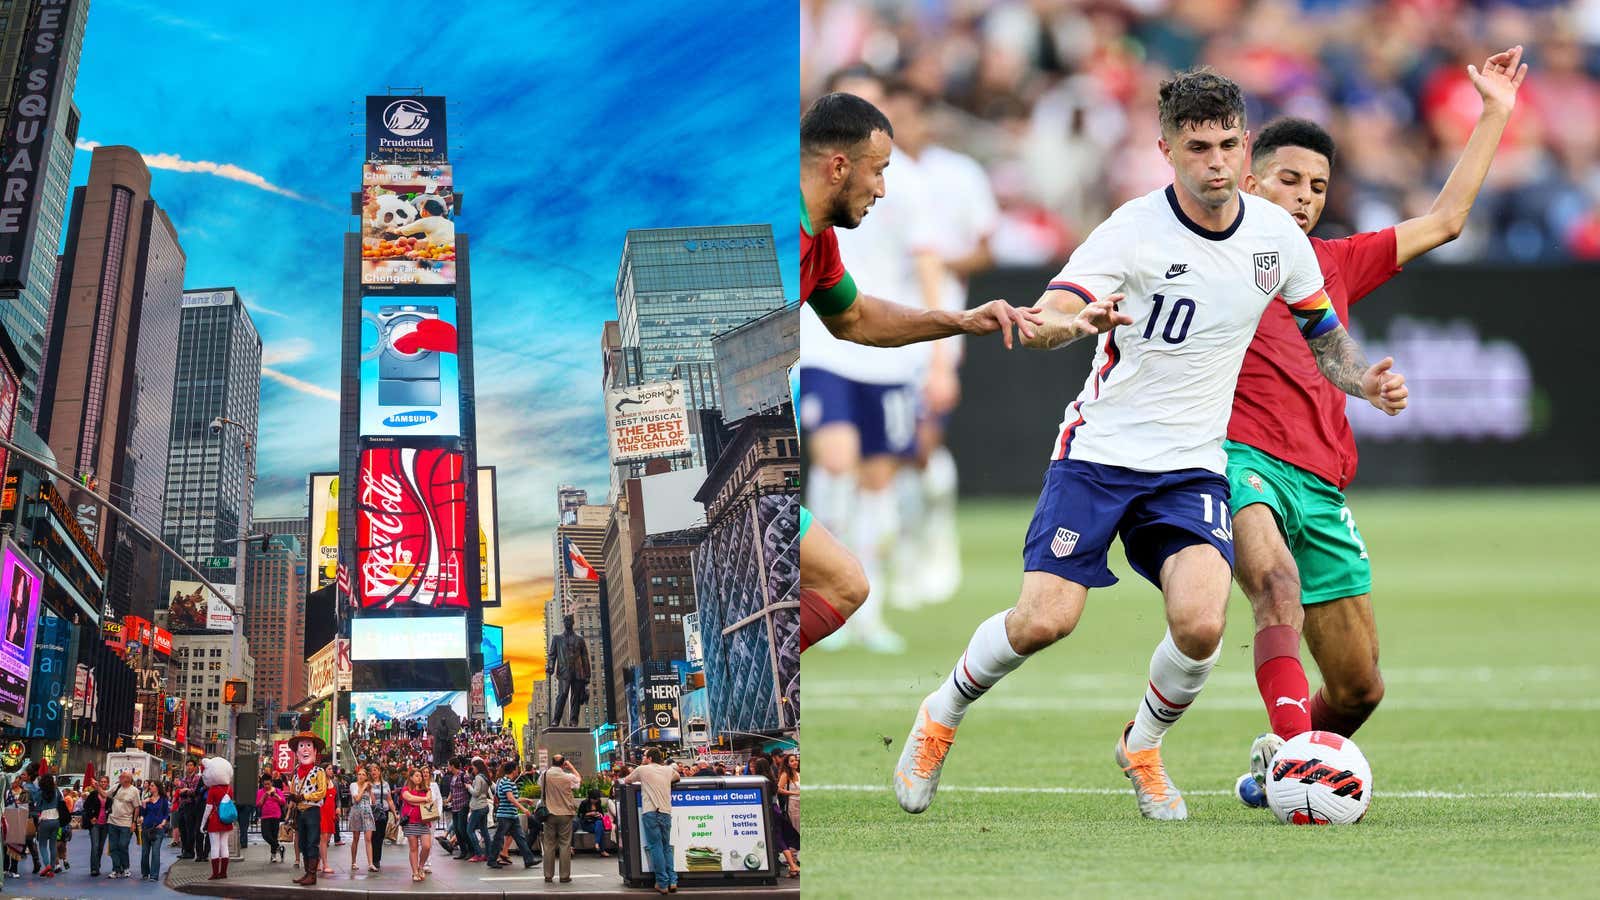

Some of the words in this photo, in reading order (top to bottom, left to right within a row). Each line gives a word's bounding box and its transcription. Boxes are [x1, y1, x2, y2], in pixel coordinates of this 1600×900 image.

[380, 138, 434, 147] Prudential
[0, 69, 48, 233] SQUARE
[702, 238, 766, 250] BARCLAYS
[1169, 263, 1189, 273] NIKE
[1257, 255, 1277, 270] USA
[1142, 293, 1197, 345] 10
[390, 415, 431, 425] SAMSUNG
[615, 418, 638, 427] BEST
[641, 412, 682, 423] MUSICAL
[647, 420, 683, 433] BEST
[617, 434, 666, 446] MUSICAL
[668, 430, 685, 439] OF
[618, 445, 639, 453] THIS
[1056, 530, 1078, 543] USA
[213, 558, 221, 567] 46
[652, 685, 680, 699] HERO
[653, 703, 668, 711] JUNE
[668, 703, 672, 711] 6
[713, 793, 728, 801] and
[688, 814, 714, 822] recycle
